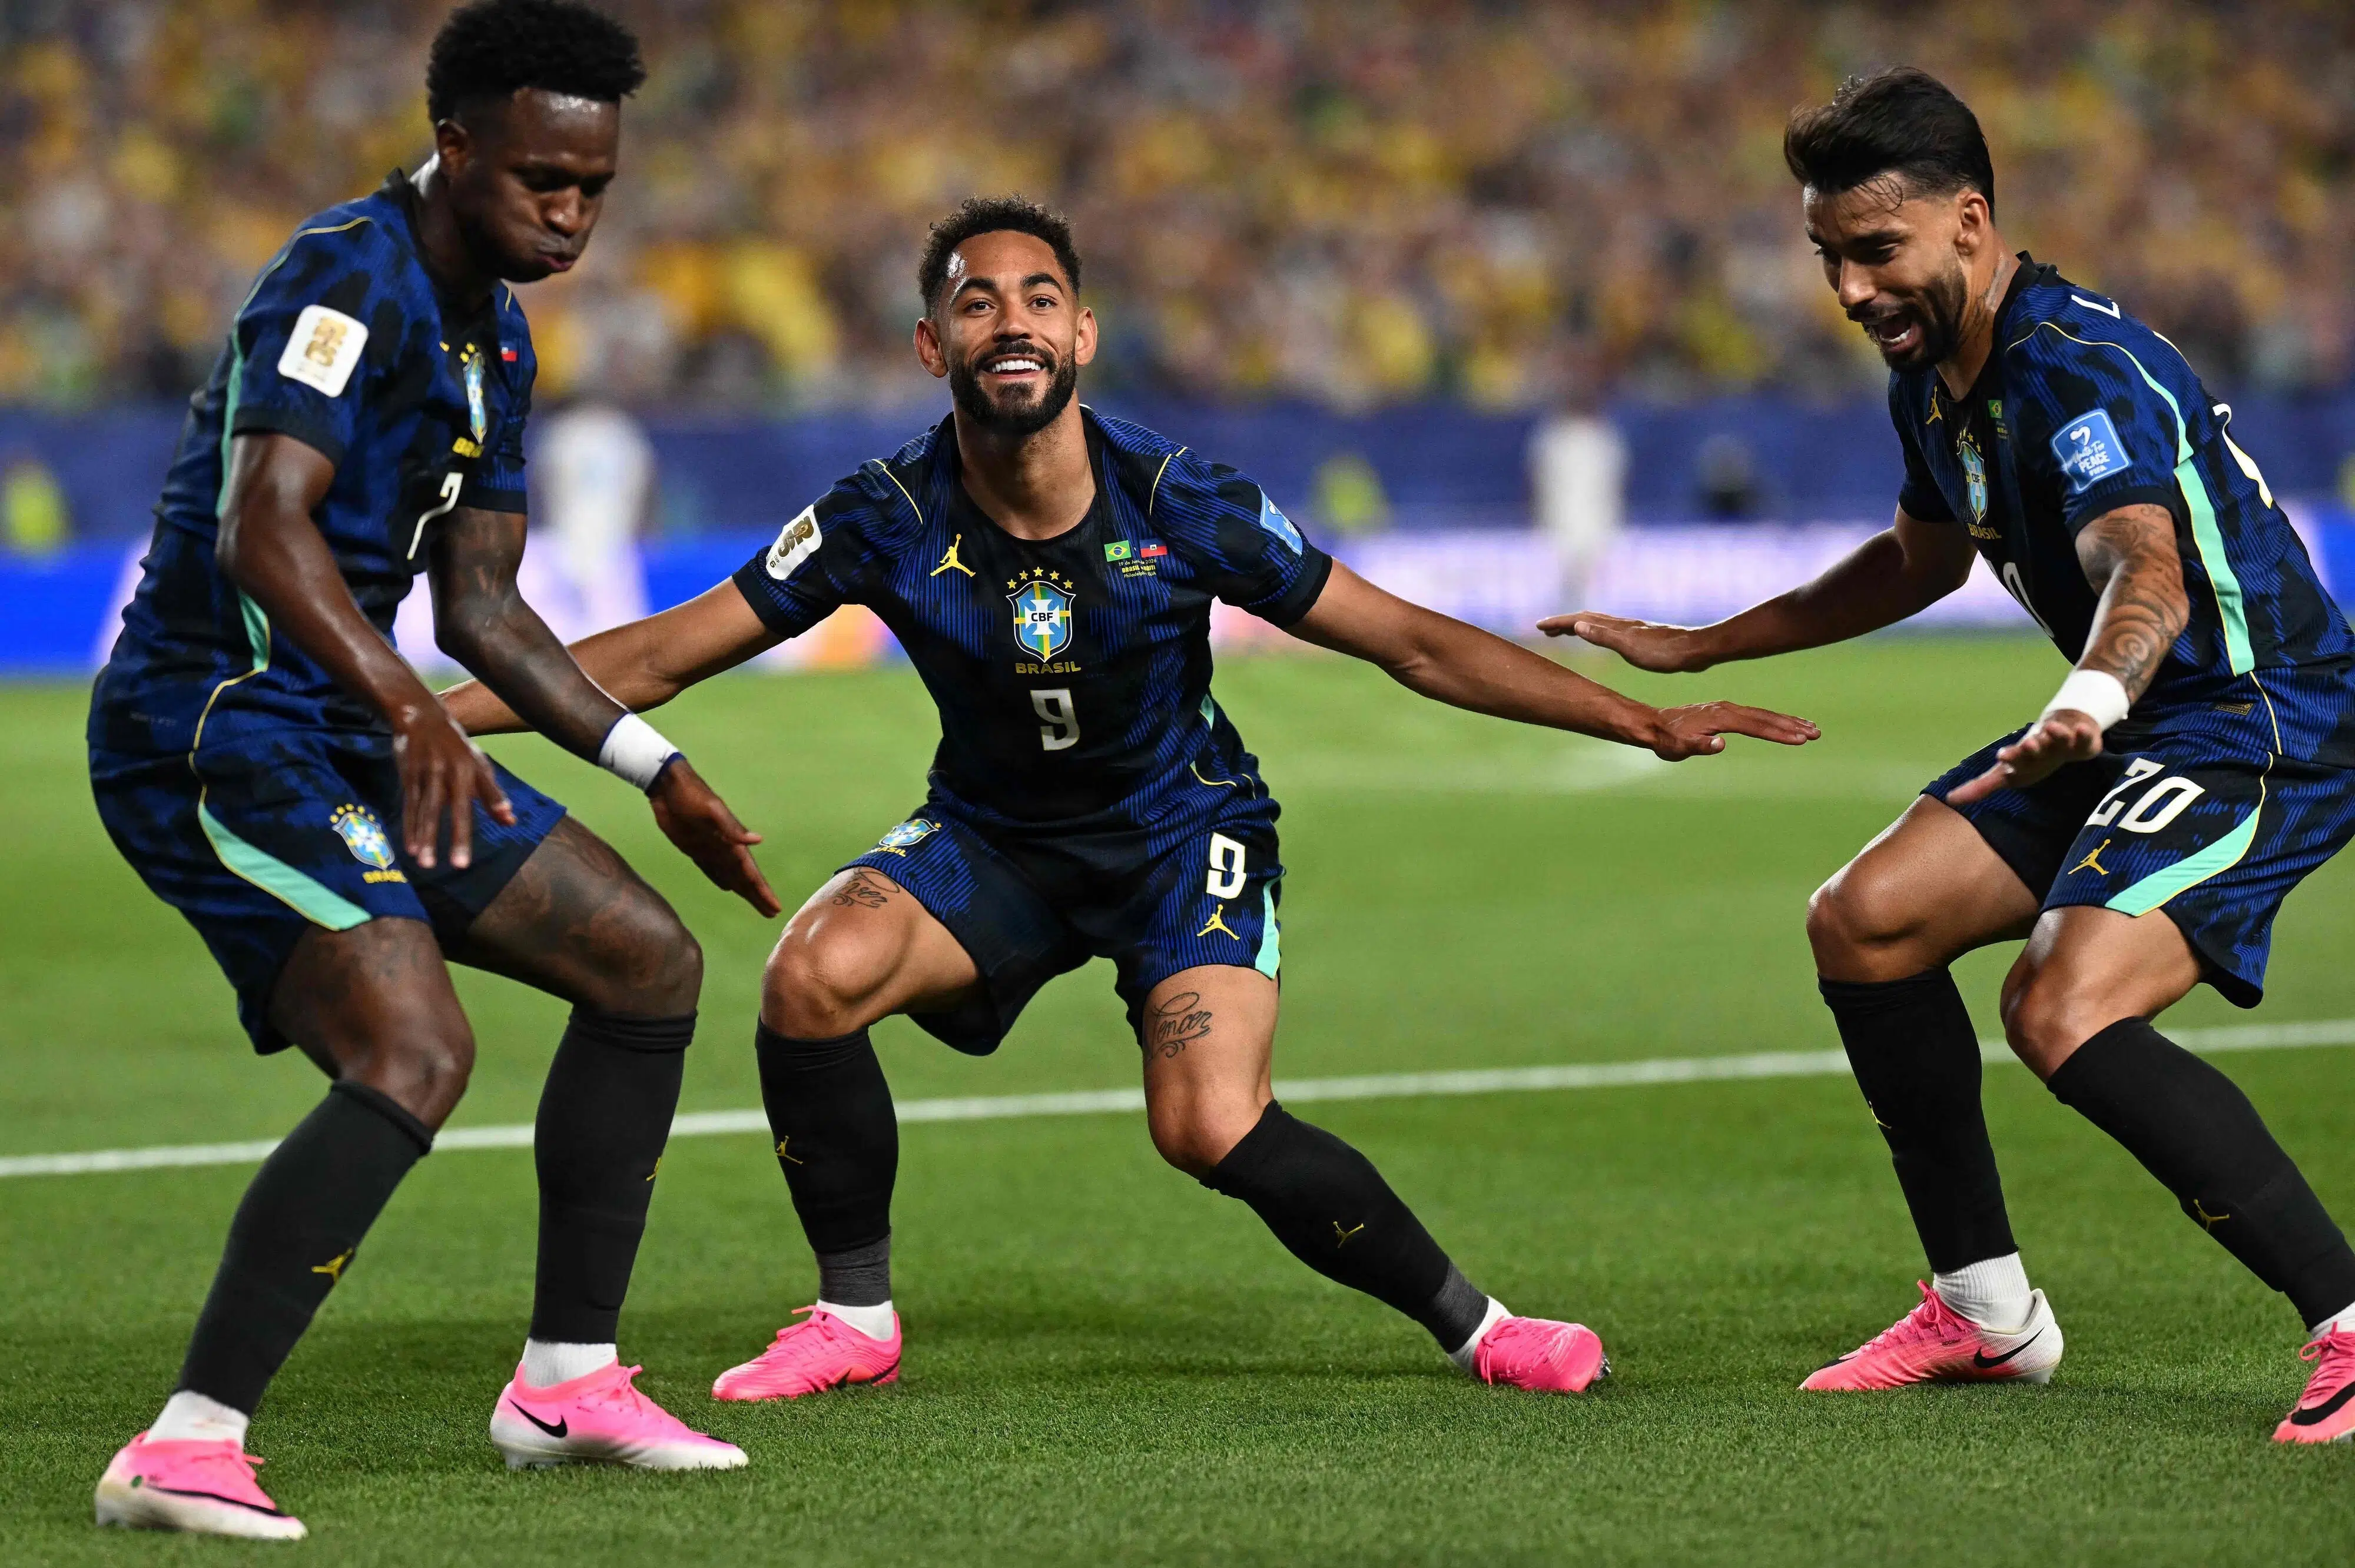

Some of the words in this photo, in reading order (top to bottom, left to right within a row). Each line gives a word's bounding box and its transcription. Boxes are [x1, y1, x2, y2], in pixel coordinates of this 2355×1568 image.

[2078, 451, 2111, 473] PEACE
[1968, 523, 2002, 540] BRASIL
[1030, 612, 1054, 622] CBF
[1014, 660, 1082, 675] BRASIL
[1029, 687, 1081, 751] 9
[2084, 757, 2207, 834] 20
[1206, 832, 1248, 899] 9
